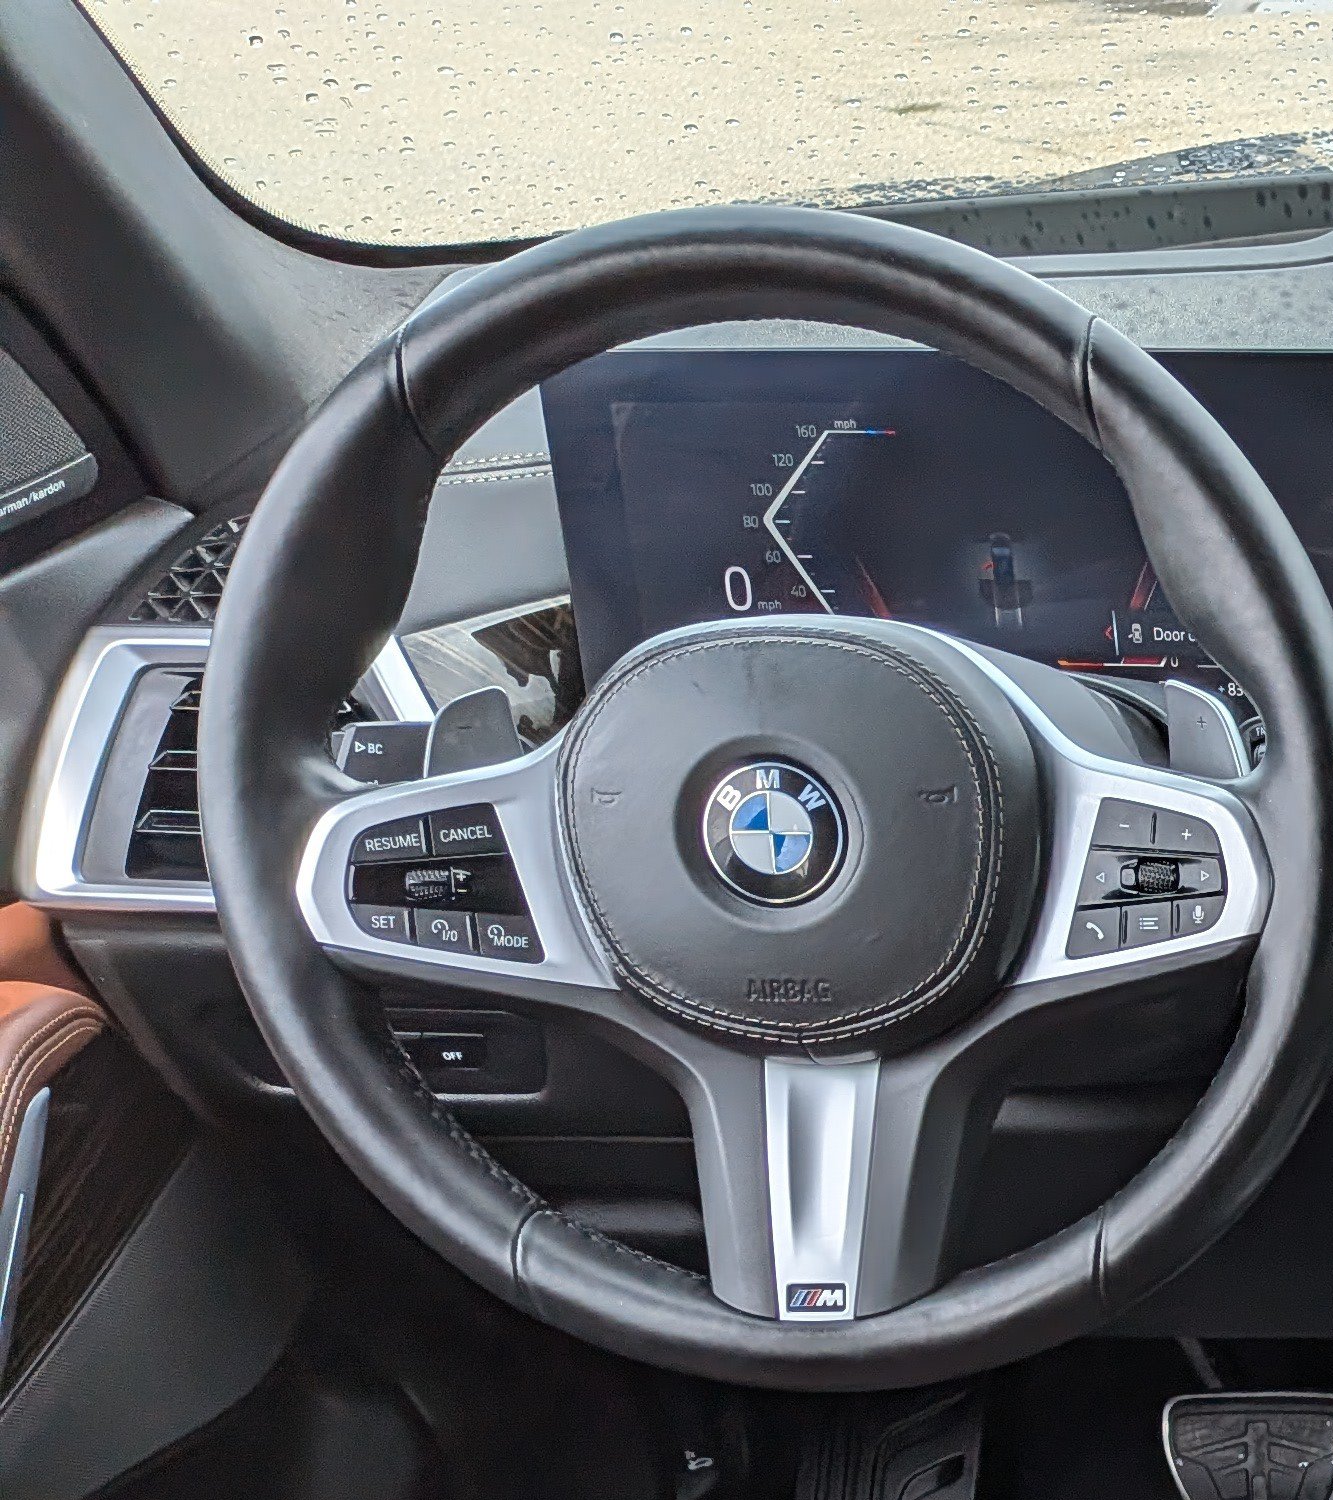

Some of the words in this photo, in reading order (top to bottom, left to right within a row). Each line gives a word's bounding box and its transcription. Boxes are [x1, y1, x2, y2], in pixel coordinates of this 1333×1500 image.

[834, 419, 857, 430] mph
[796, 425, 817, 438] 160
[772, 453, 794, 467] 120
[750, 483, 773, 496] 100
[743, 515, 759, 528] 80
[765, 550, 781, 563] 60
[724, 565, 752, 611] 0
[757, 600, 782, 611] mph
[790, 585, 807, 598] 40
[1153, 627, 1185, 642] Door
[368, 743, 383, 754] BC
[716, 768, 827, 812] BMW
[365, 833, 421, 851] RESUME
[440, 826, 493, 843] CANCEL
[371, 915, 396, 928] SET
[493, 934, 529, 948] MODE
[746, 978, 832, 1002] AIRBAG
[442, 1051, 462, 1060] OFF
